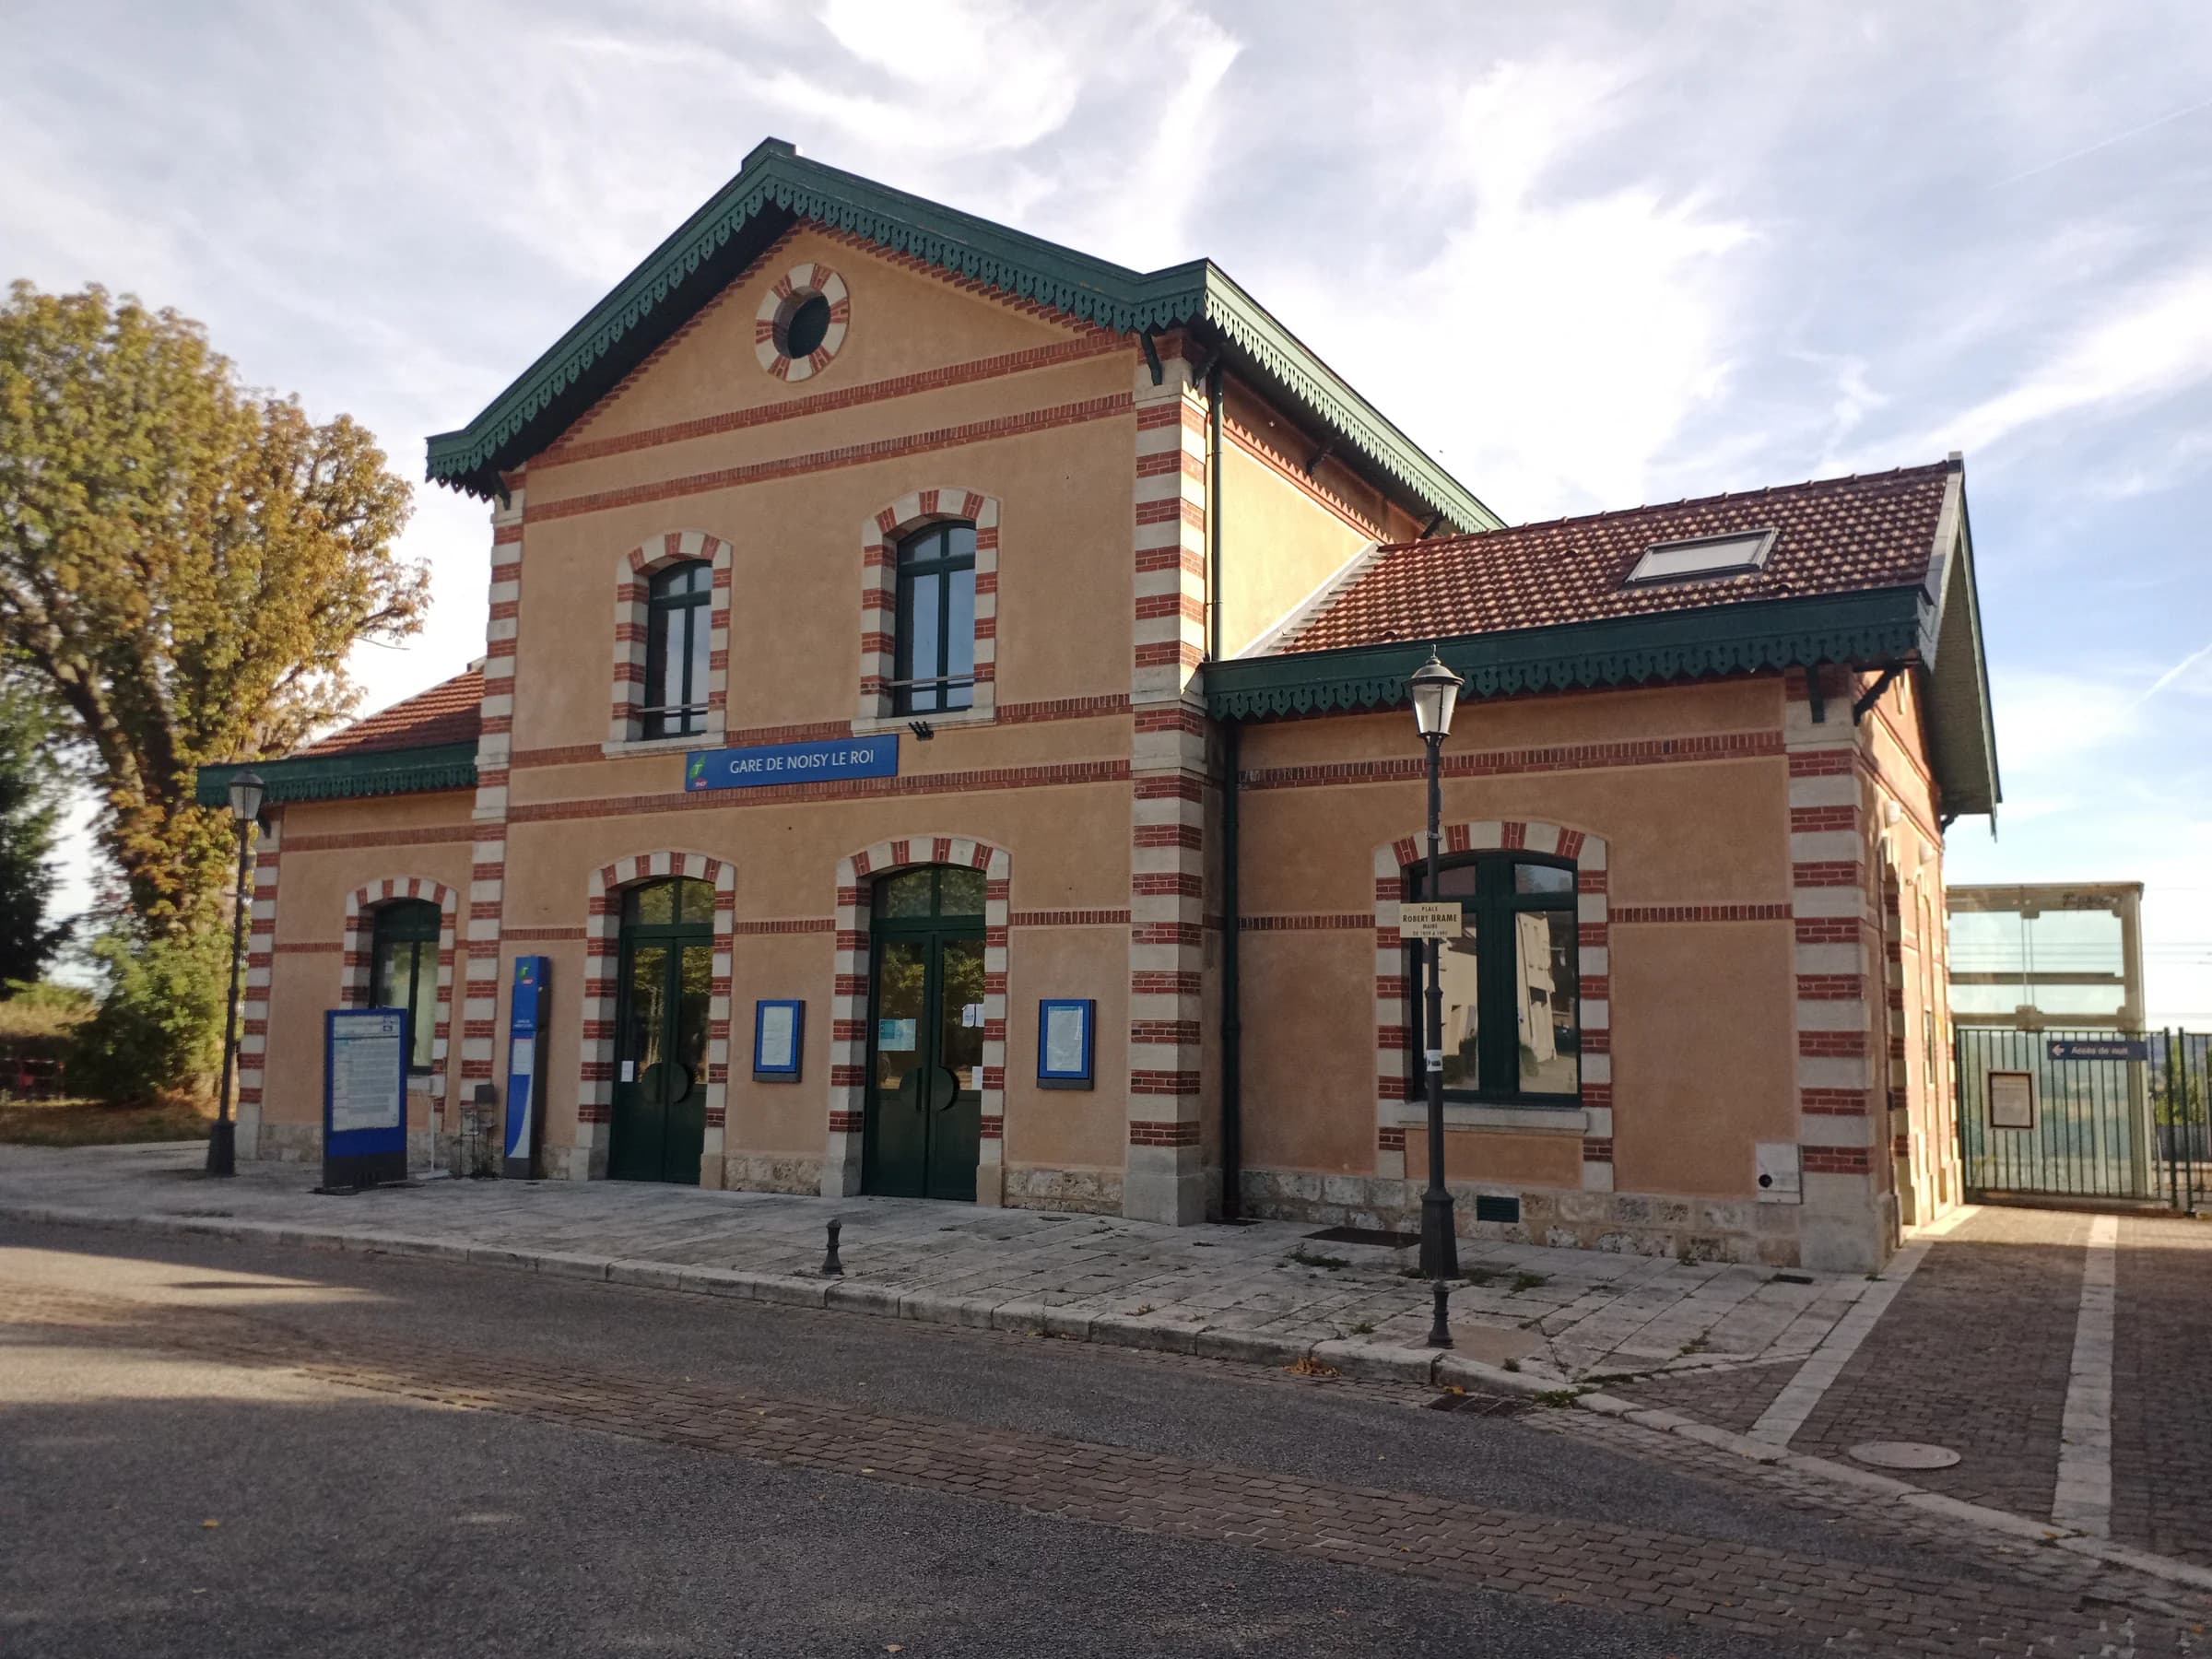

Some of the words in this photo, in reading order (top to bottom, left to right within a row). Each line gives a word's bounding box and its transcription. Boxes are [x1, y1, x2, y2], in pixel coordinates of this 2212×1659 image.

[730, 759, 763, 774] GARE
[766, 758, 783, 771] DE
[787, 753, 830, 770] NOISY
[832, 751, 846, 766] LE
[851, 749, 875, 764] ROI
[1402, 914, 1429, 923] ROBERT
